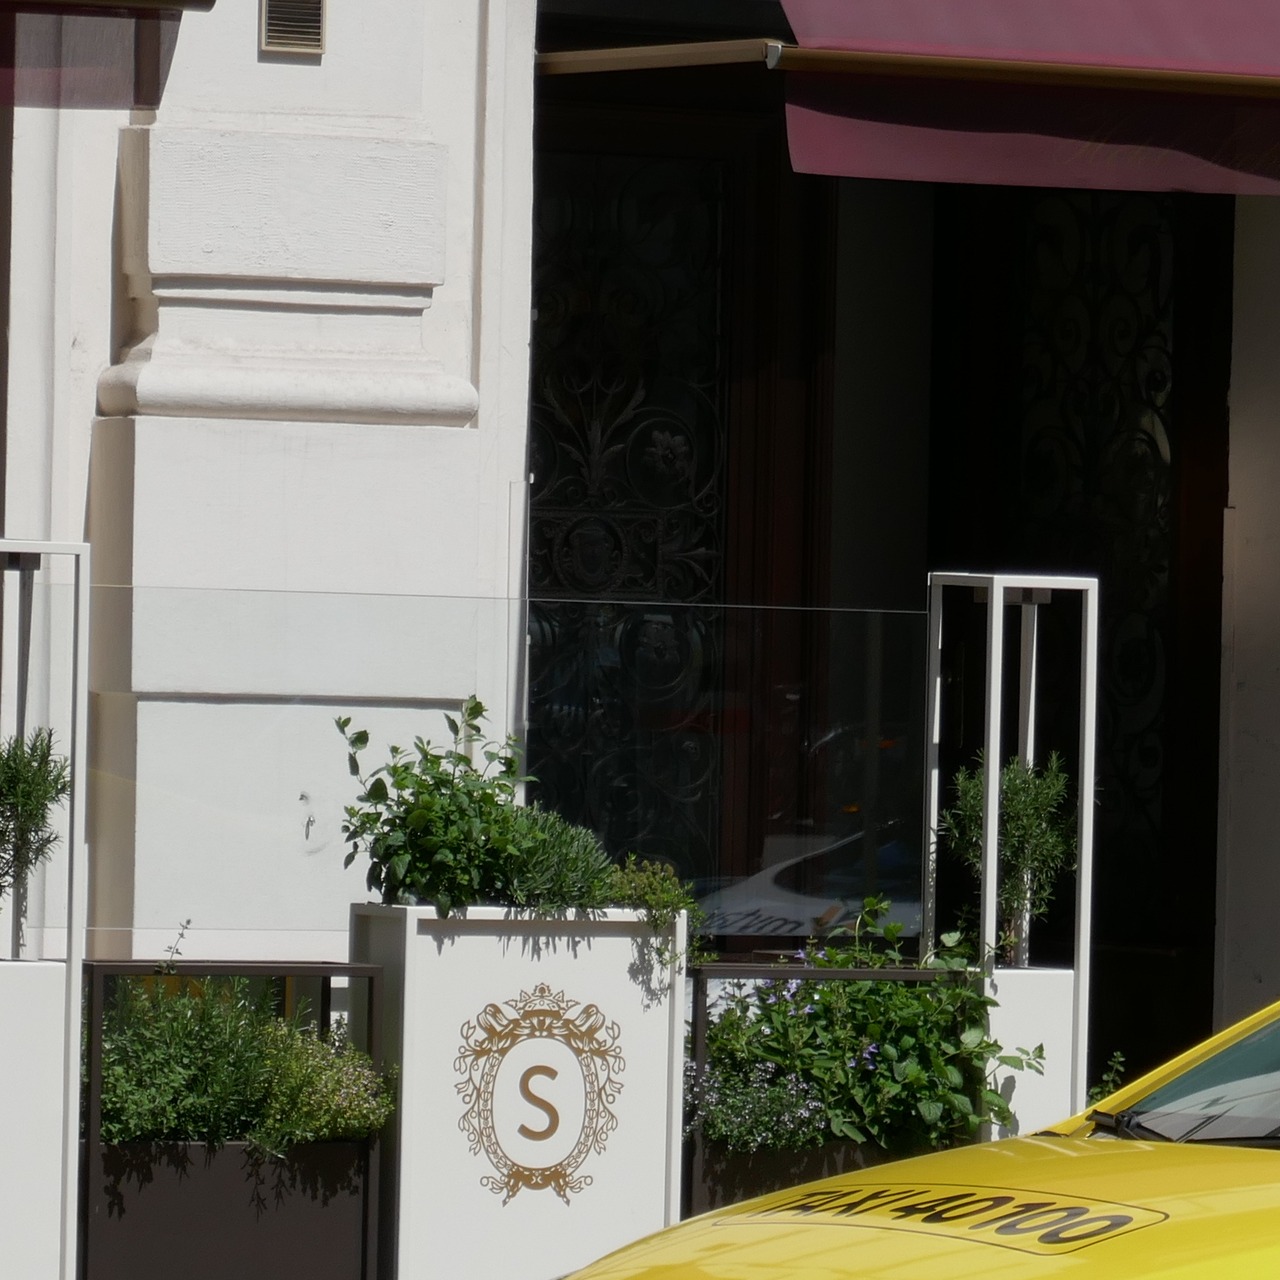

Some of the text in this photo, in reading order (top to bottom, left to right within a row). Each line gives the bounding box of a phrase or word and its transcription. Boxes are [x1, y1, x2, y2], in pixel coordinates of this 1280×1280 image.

[517, 1063, 561, 1144] S
[746, 1188, 1134, 1245] TAXI 40100
